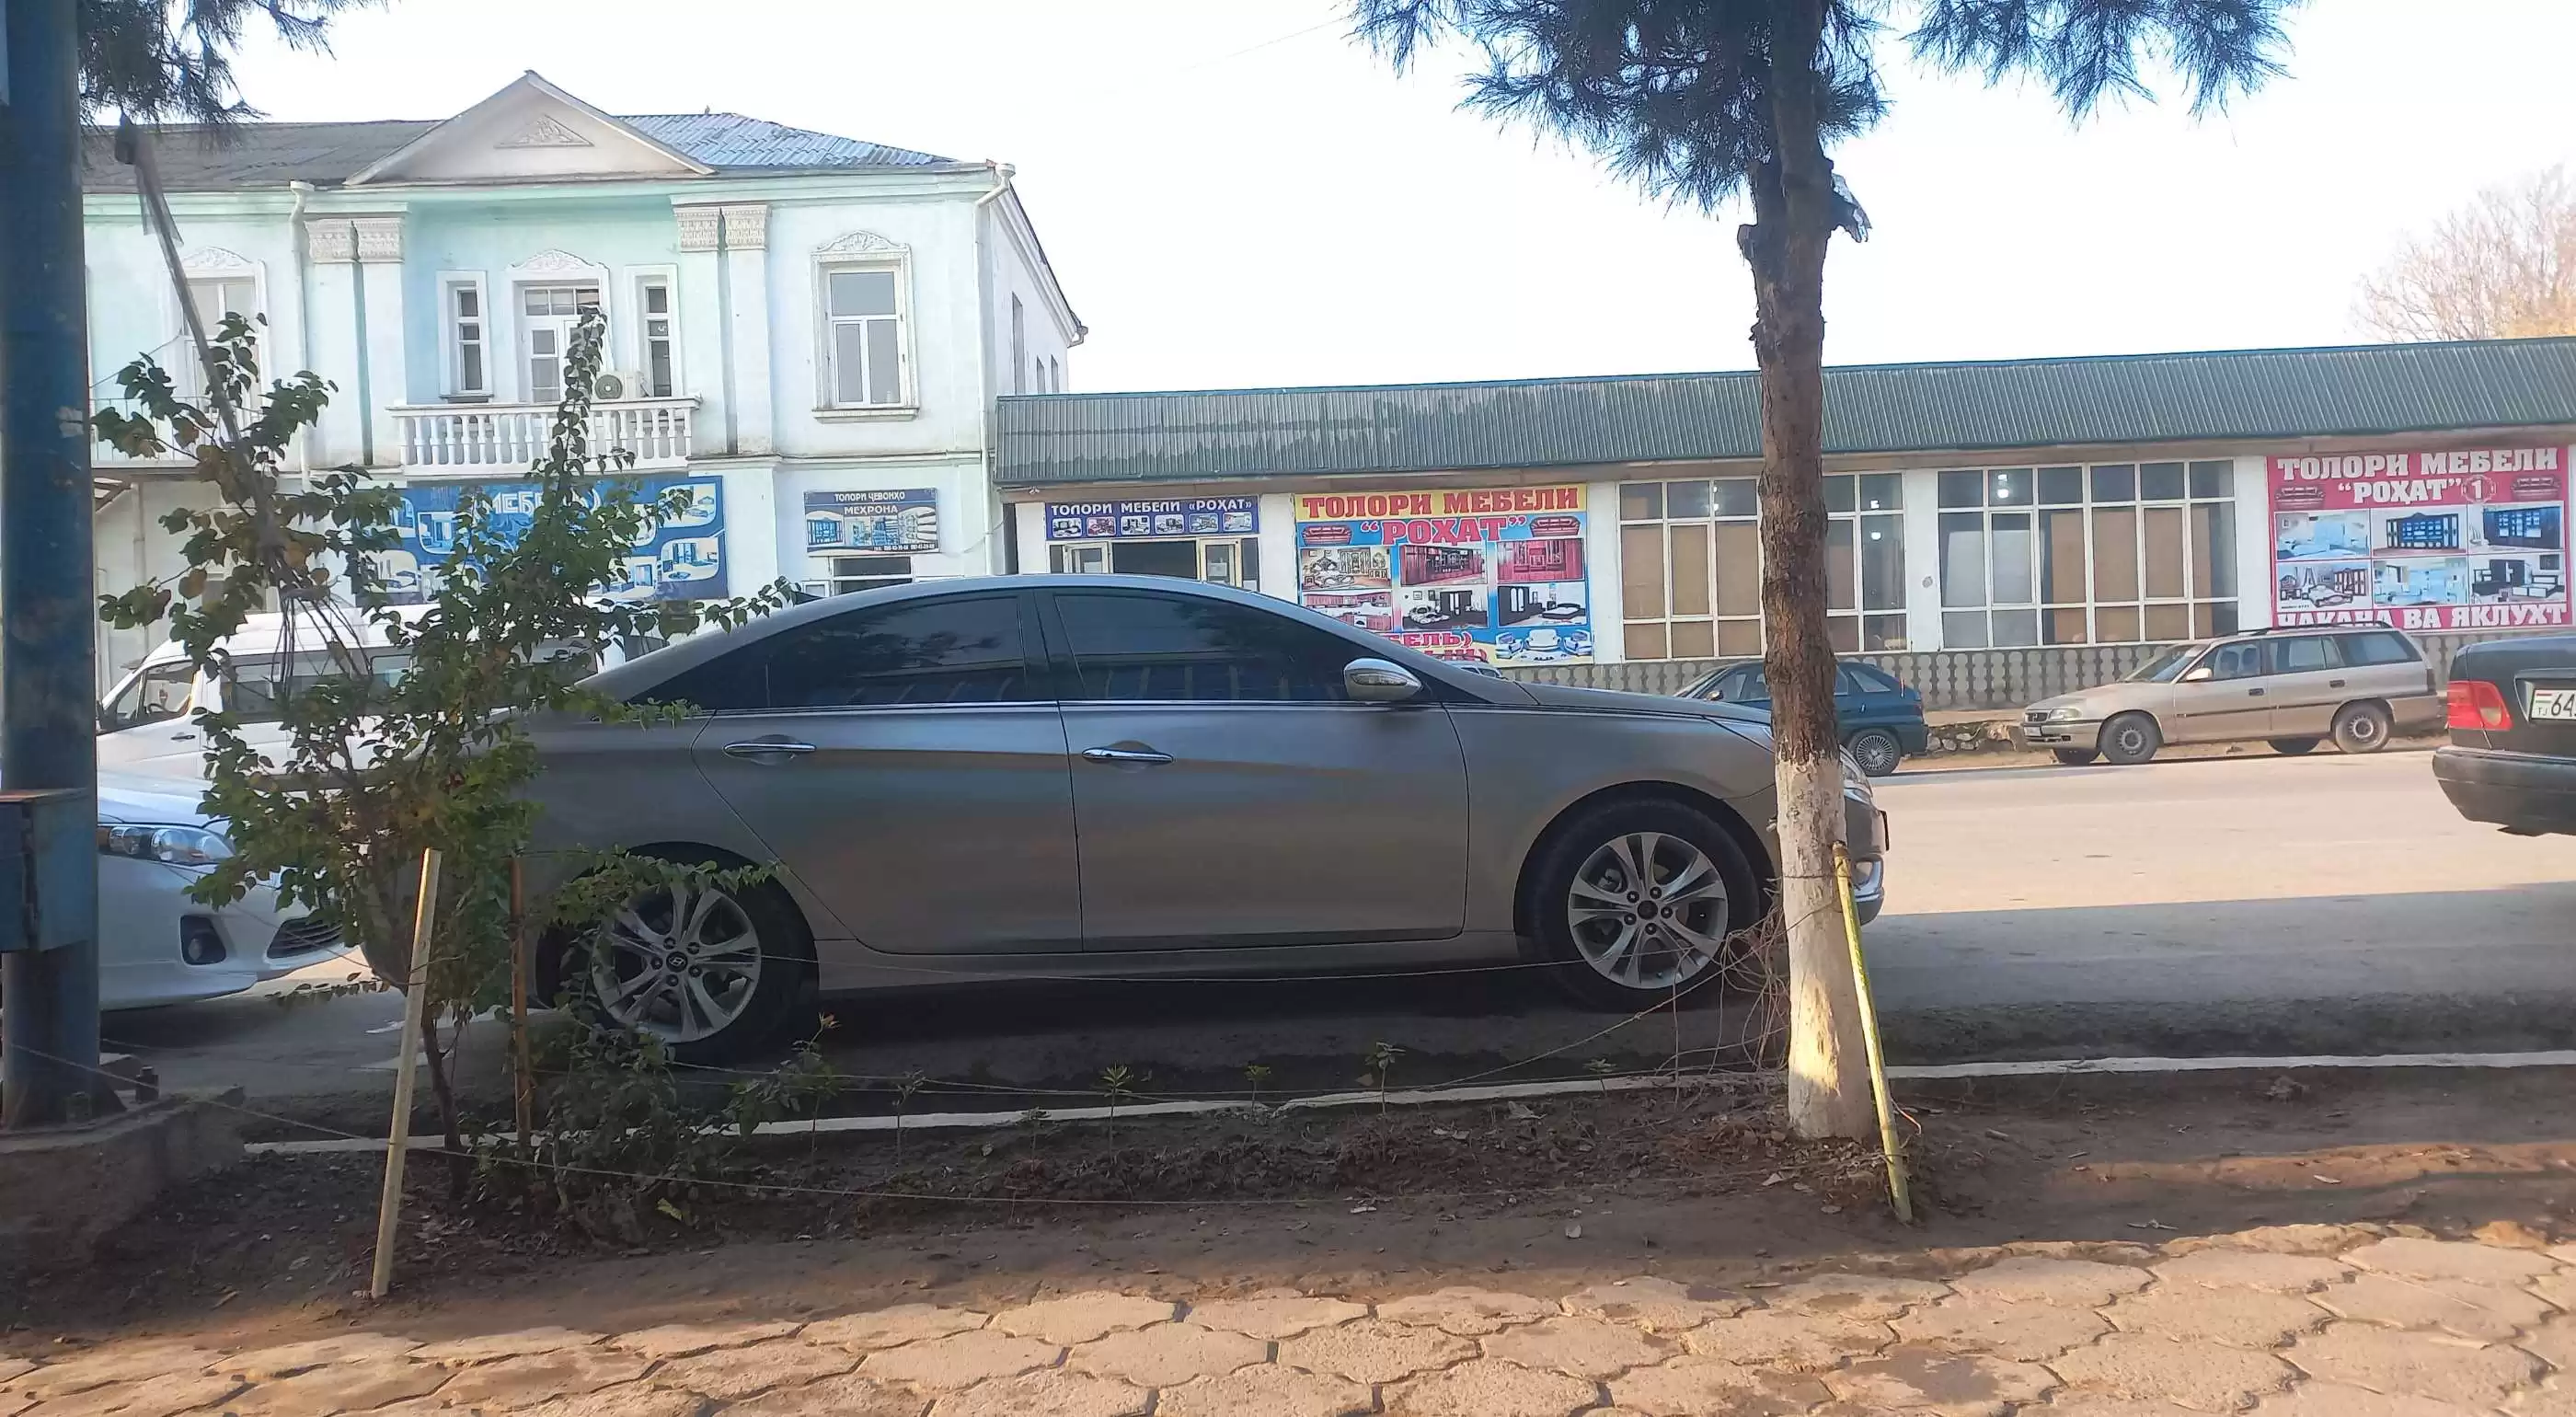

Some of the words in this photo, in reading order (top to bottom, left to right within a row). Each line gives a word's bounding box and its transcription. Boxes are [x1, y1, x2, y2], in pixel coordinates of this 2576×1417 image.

[2277, 454, 2409, 481] ТОЛОРИ
[2421, 448, 2558, 477] МЕБЕЛИ
[1052, 503, 1113, 516] ТОЛОРИ
[1121, 501, 1180, 514] МЕБЕЛИ
[1303, 494, 1432, 518] ТОЛОРИ
[1443, 488, 1579, 513] МЕБЕЛИ
[2404, 606, 2441, 629] ВА
[2451, 603, 2567, 628] ЯКЛУХТ
